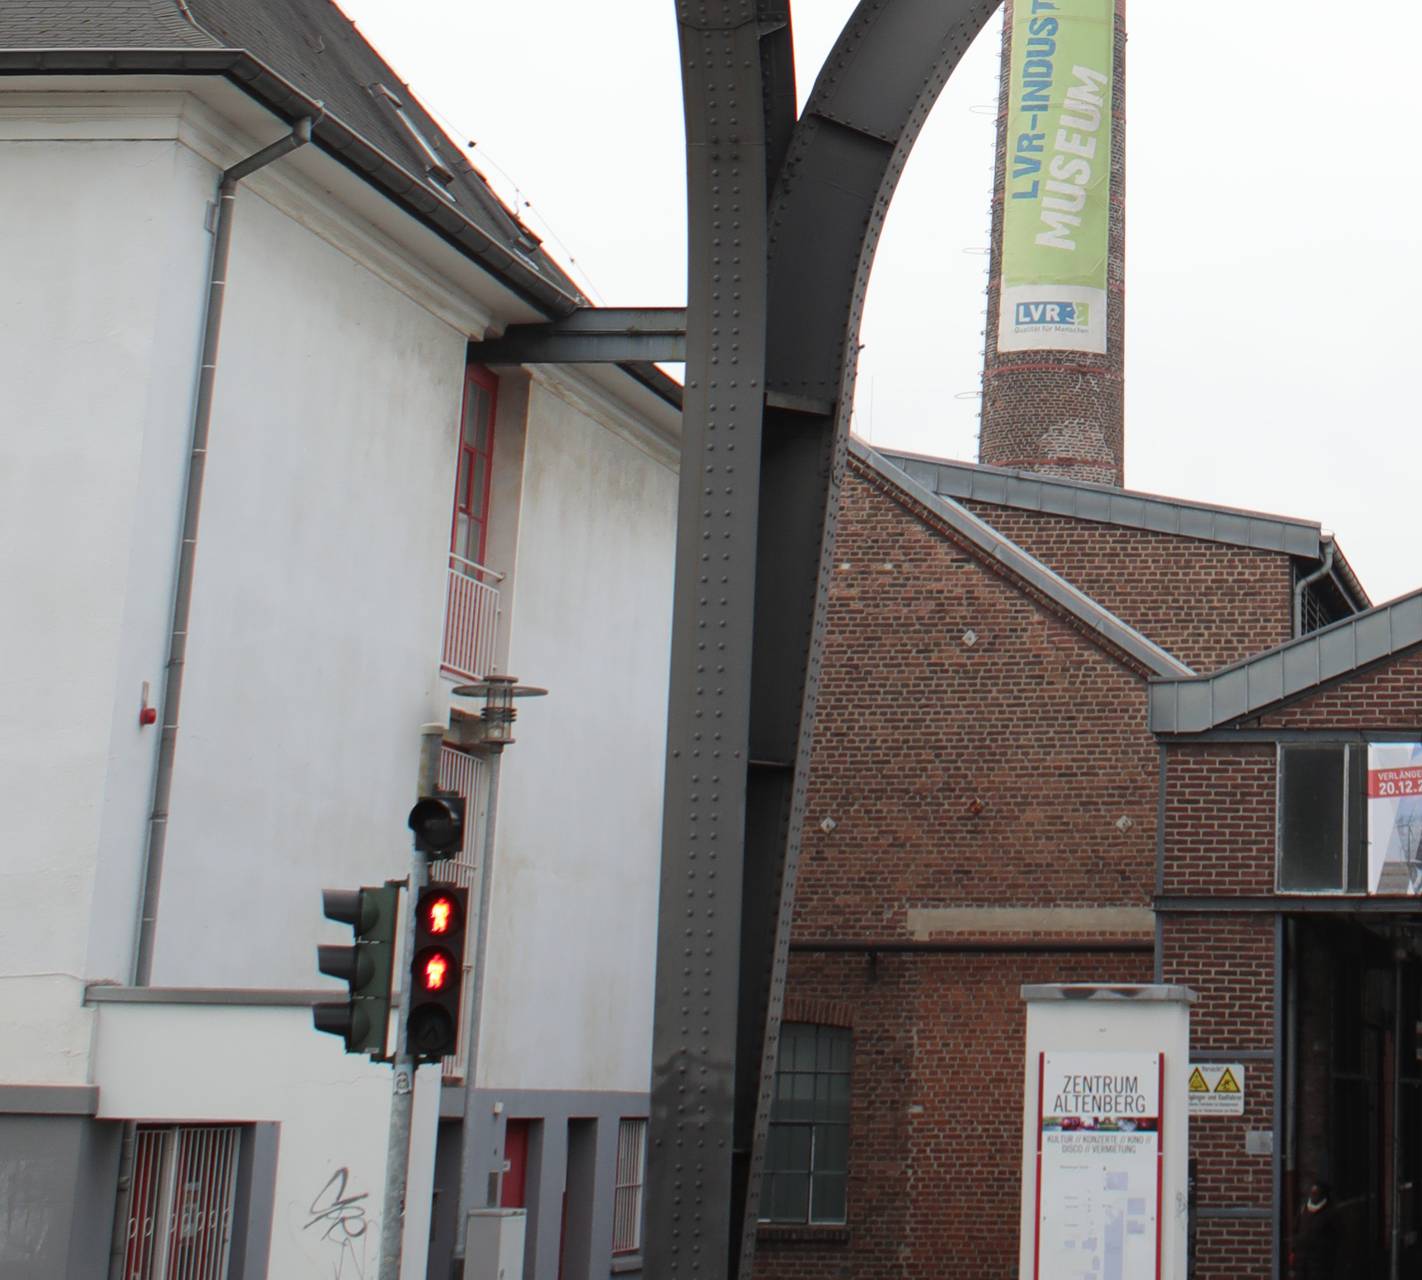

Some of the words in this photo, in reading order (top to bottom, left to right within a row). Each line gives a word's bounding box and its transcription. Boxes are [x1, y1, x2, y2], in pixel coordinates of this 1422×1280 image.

[1035, 64, 1108, 250] MUSEUM
[1018, 303, 1060, 322] LVR
[1062, 1075, 1139, 1094] ZENTRUM
[1053, 1094, 1147, 1113] ALTENBERG
[1047, 1134, 1074, 1144] KULTUR
[1082, 1134, 1118, 1144] KONZERTE
[1127, 1134, 1144, 1144] KINO
[1061, 1144, 1083, 1154] DISCO
[1091, 1144, 1137, 1154] VERMIETUNG
